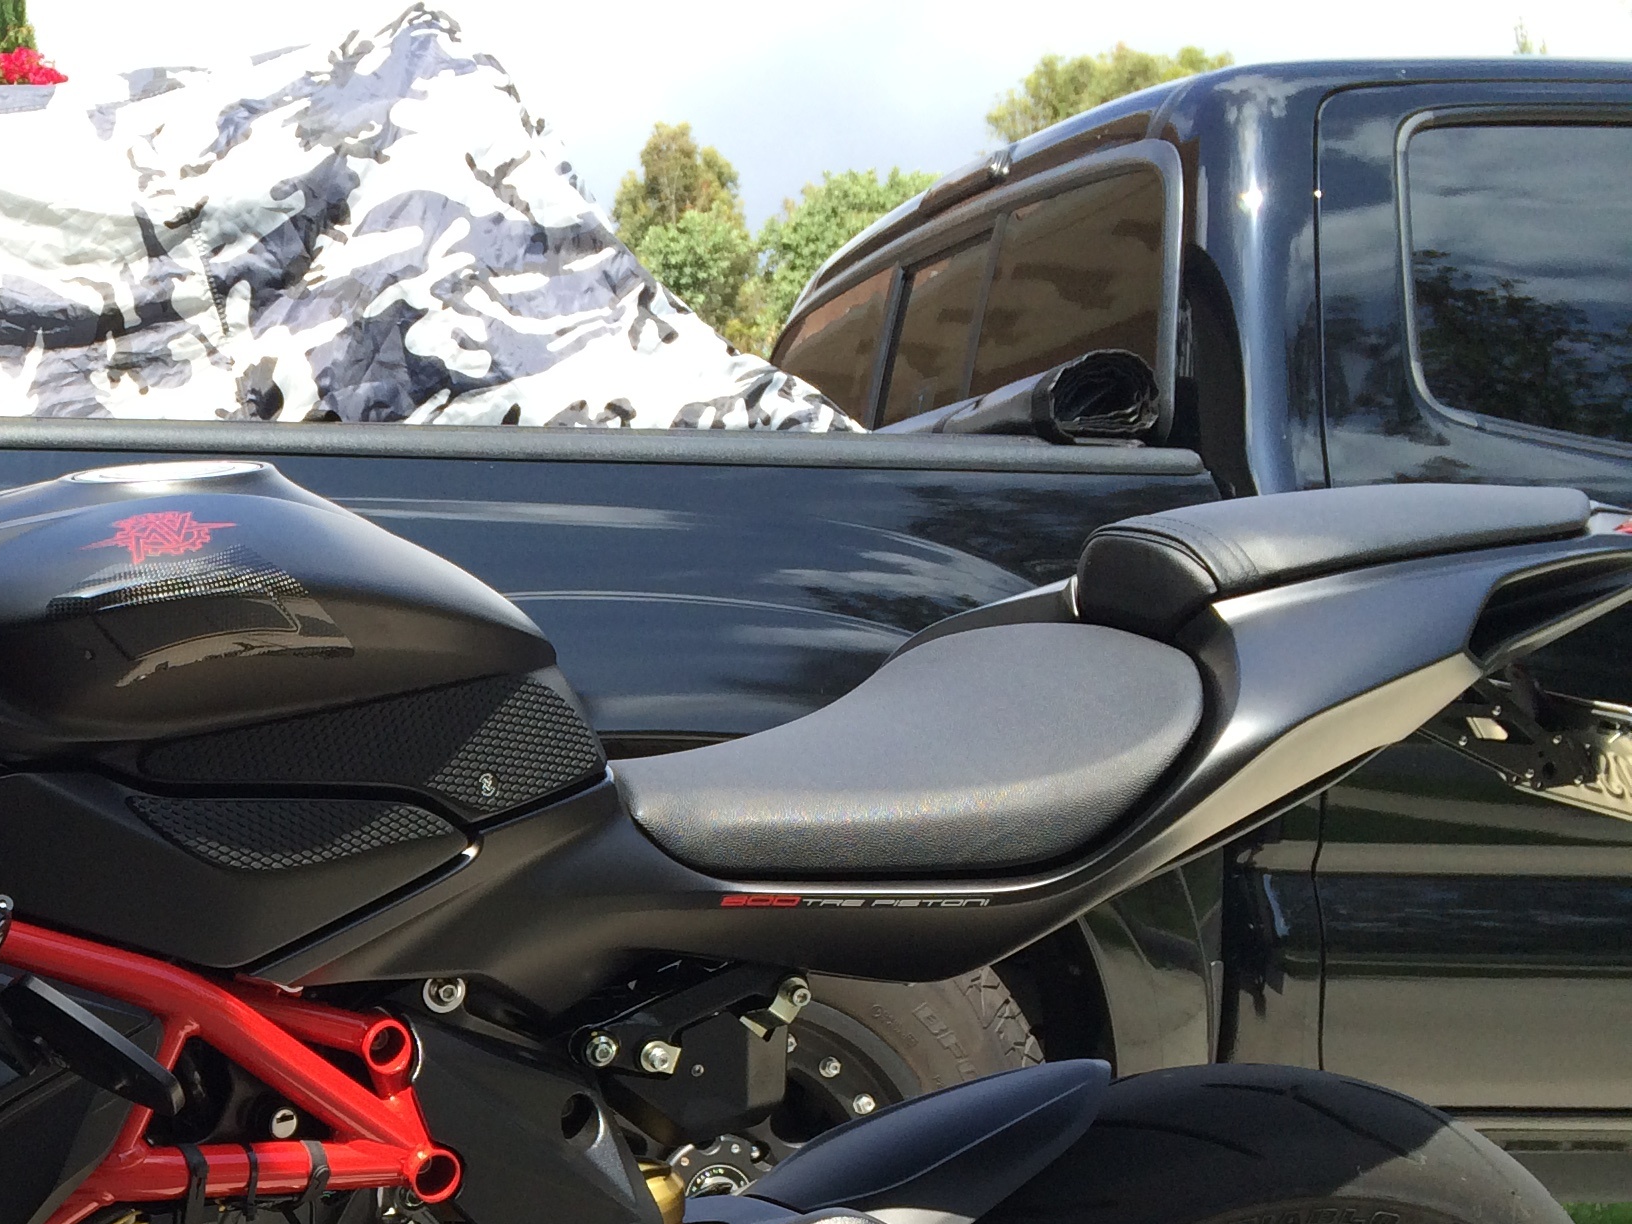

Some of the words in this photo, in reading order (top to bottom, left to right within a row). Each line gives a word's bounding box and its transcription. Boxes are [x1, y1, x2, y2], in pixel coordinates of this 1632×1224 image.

[720, 895, 801, 907] 800
[802, 898, 867, 907] TRE
[870, 897, 991, 907] PISTONI
